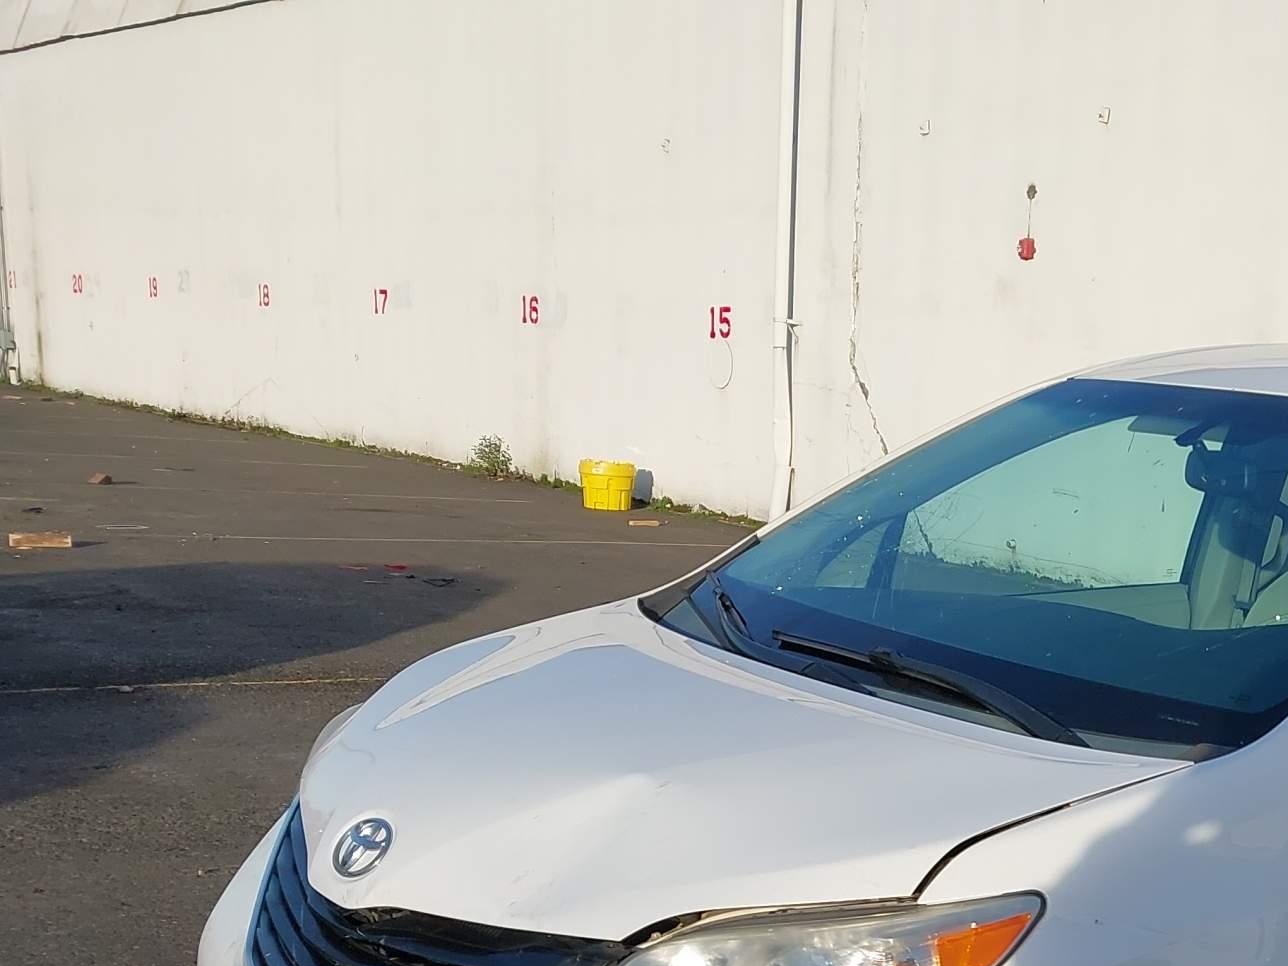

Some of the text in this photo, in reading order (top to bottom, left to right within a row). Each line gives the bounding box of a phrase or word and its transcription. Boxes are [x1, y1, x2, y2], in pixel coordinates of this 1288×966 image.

[72, 274, 83, 294] 20
[148, 276, 158, 298] 19
[258, 284, 270, 307] 18
[374, 289, 388, 314] 17
[522, 296, 539, 324] 16
[709, 305, 732, 339] 15
